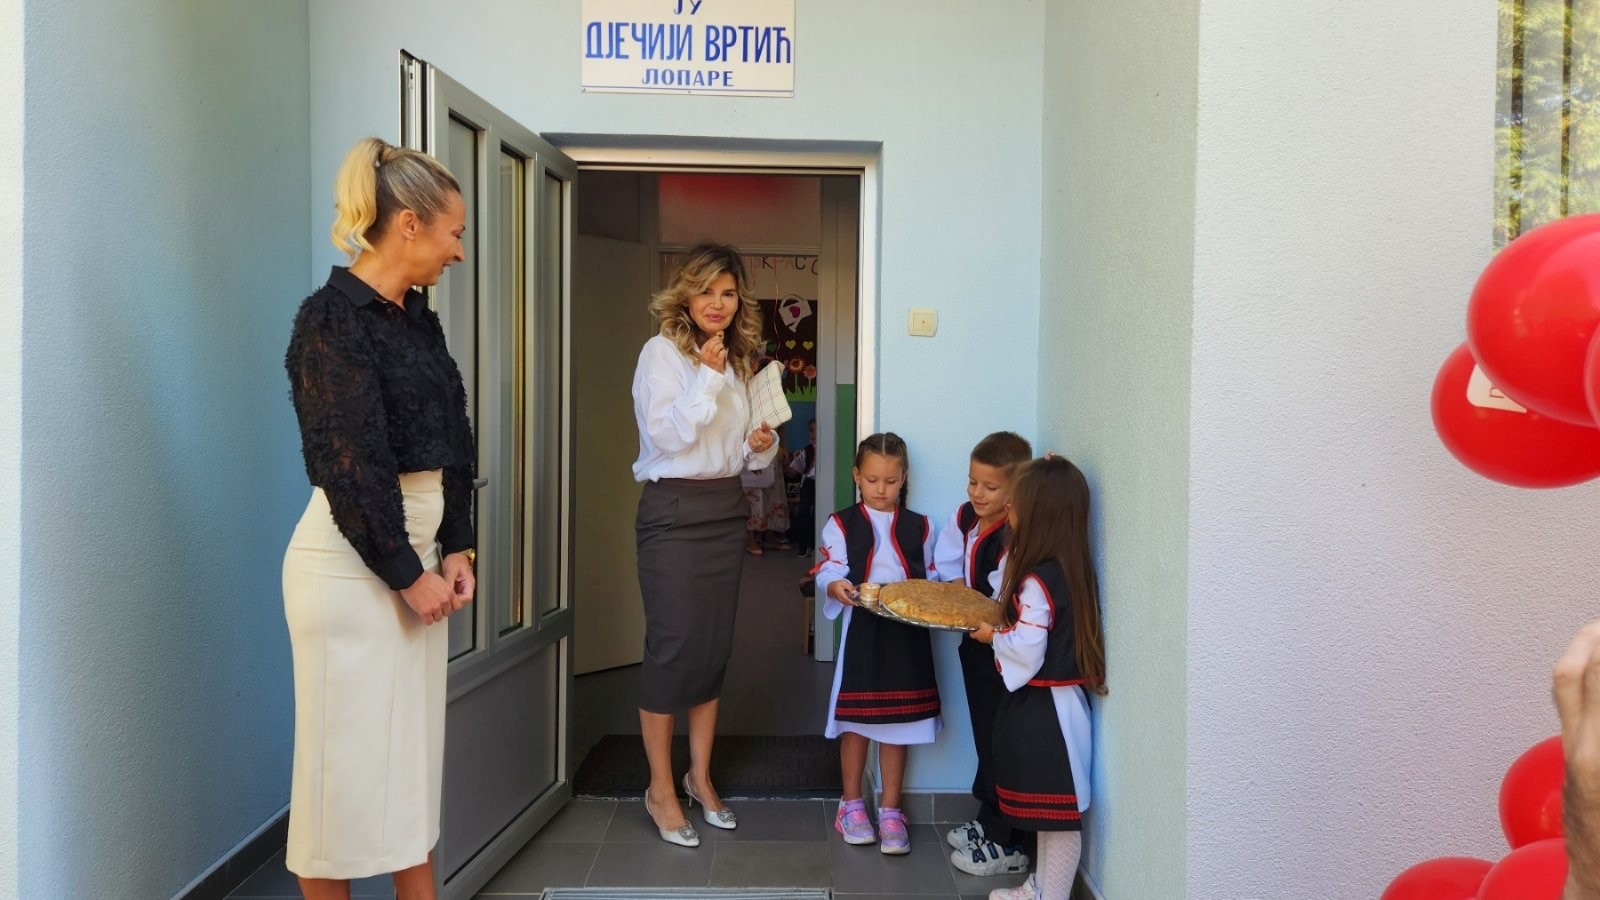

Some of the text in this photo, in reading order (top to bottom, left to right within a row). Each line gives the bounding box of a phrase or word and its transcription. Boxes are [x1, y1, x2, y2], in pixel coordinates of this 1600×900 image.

[585, 21, 792, 64] ДЈЕЧИЈИ ВРТИЋ
[641, 68, 734, 87] ЛОПАРЕ
